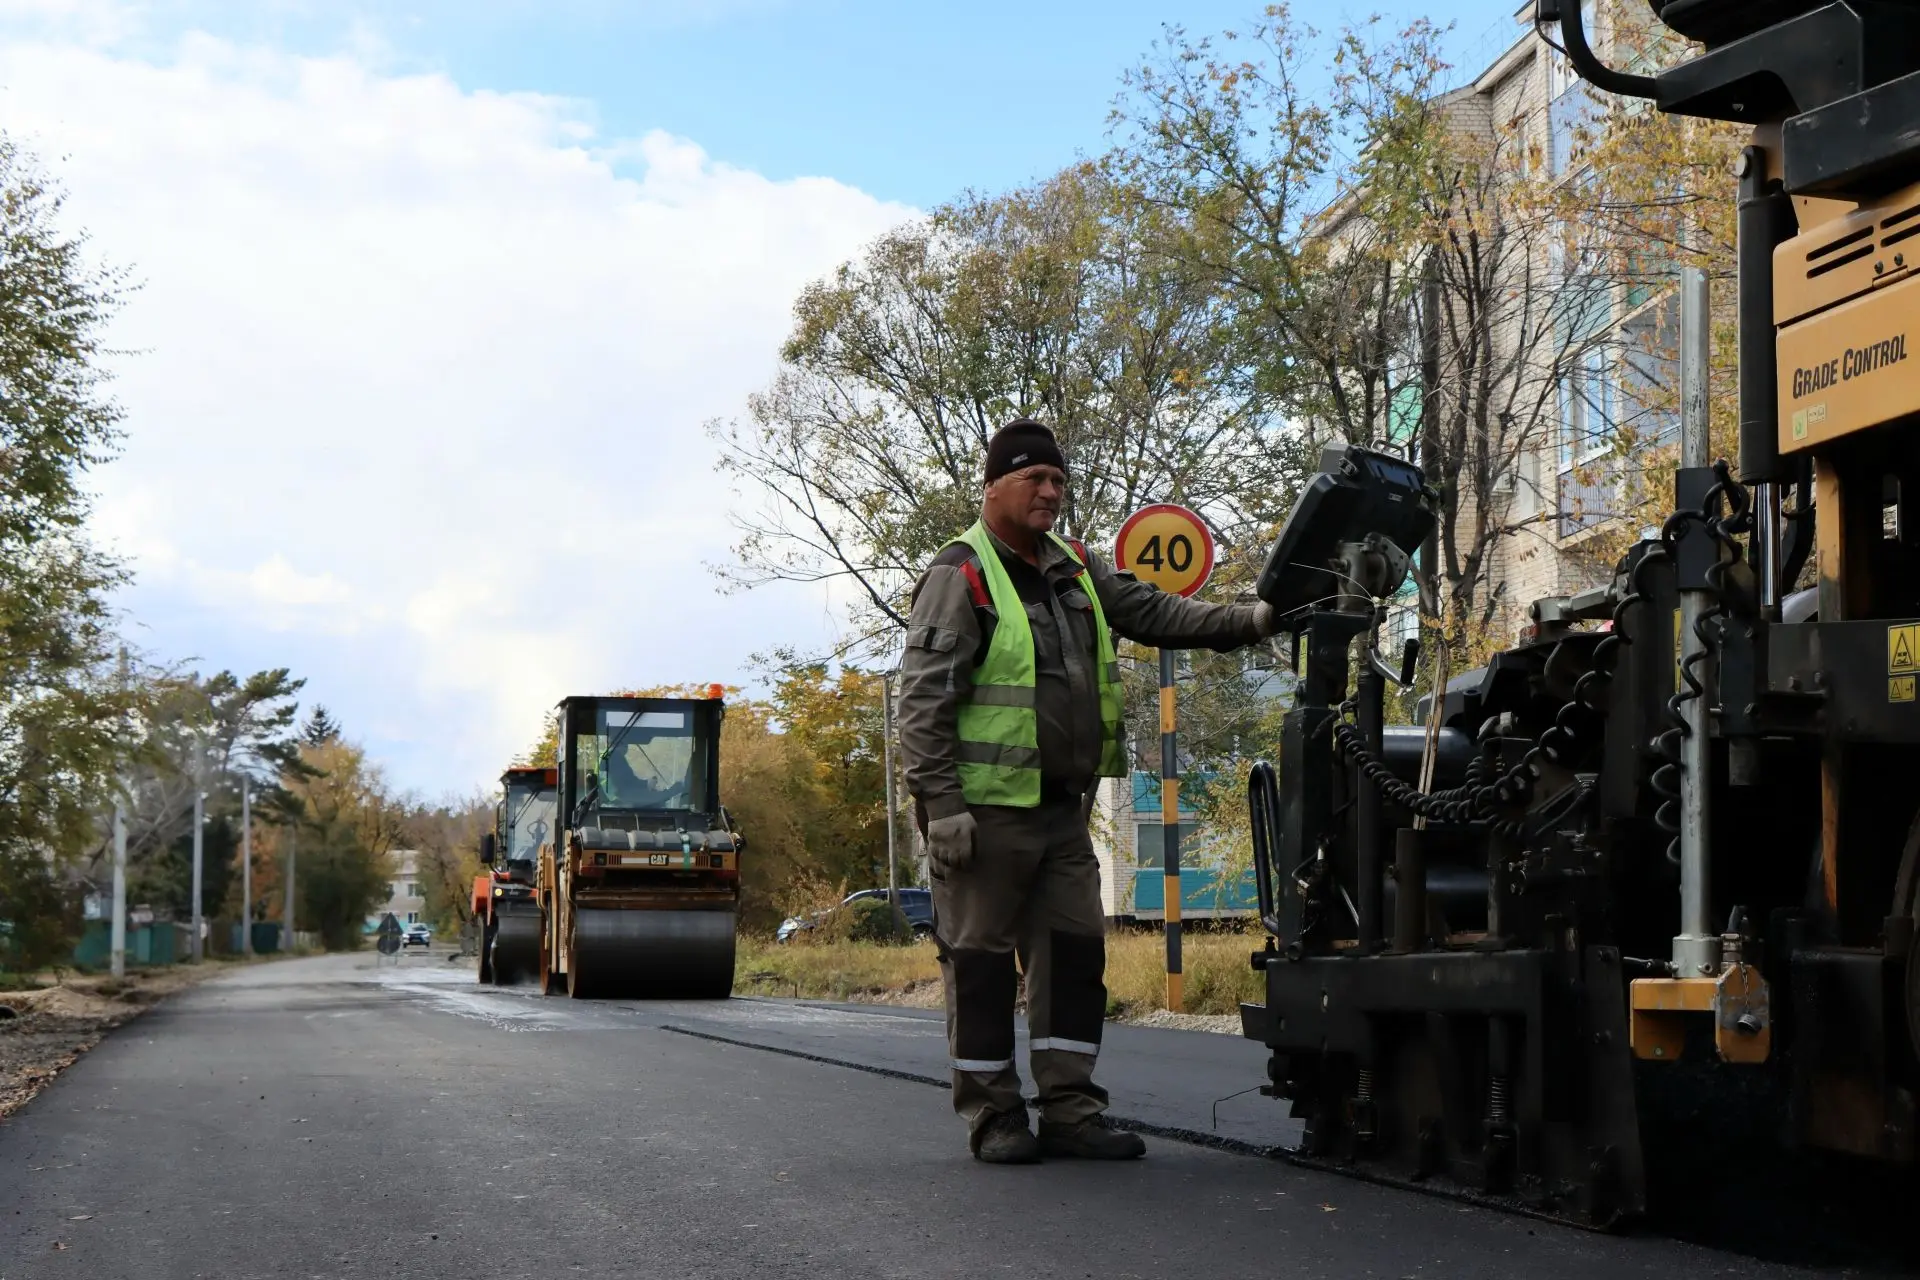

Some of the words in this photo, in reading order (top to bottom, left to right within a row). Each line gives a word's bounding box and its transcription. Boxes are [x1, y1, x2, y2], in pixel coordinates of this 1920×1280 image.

[1793, 359, 1838, 399] GRADE
[1842, 334, 1907, 380] CONTROL
[1136, 534, 1193, 572] 40
[650, 854, 667, 865] CAT
